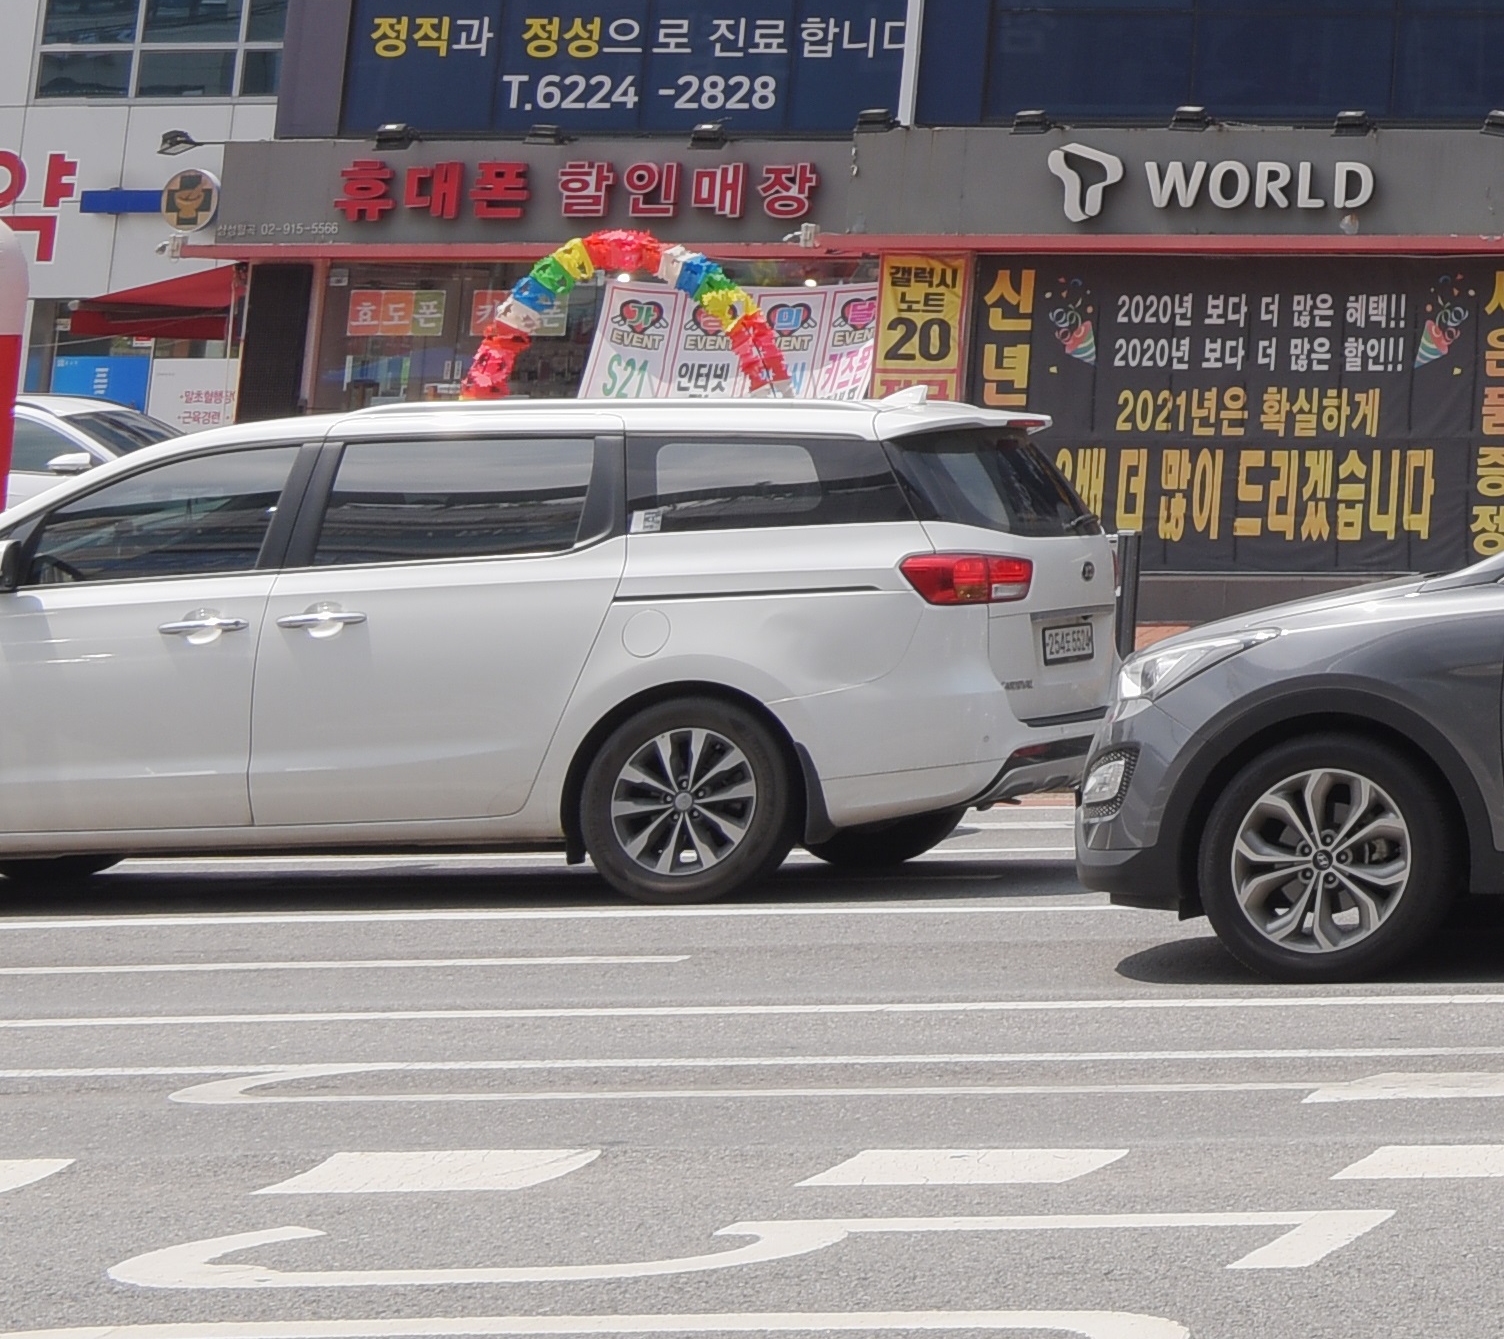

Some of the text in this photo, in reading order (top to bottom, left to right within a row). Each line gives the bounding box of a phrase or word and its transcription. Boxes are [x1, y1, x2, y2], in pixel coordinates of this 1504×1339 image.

[370, 14, 495, 59] 정직과
[334, 158, 819, 222] 휴대폰 할인매장
[1144, 159, 1376, 210] WORLD
[260, 222, 339, 236] 02-915-5566
[889, 265, 959, 289] 갤럭시
[351, 299, 442, 327] 효도폰
[898, 292, 946, 313] 노트
[1116, 292, 1194, 326] 2020년
[1205, 293, 1247, 326] 보다
[1260, 295, 1280, 326] 더
[1291, 294, 1334, 329] 많은
[610, 330, 664, 350] EVENT
[884, 317, 951, 362] 20
[1113, 336, 1190, 370] 2020년
[1201, 336, 1244, 371] 보다
[1257, 337, 1277, 371] 더
[1289, 337, 1330, 371] 많은
[602, 353, 650, 399] S21
[677, 362, 731, 394] 인터넷
[1116, 387, 1380, 438] 2021년은 확실하게
[1116, 447, 1434, 542] 더 많이 드리겠습니다
